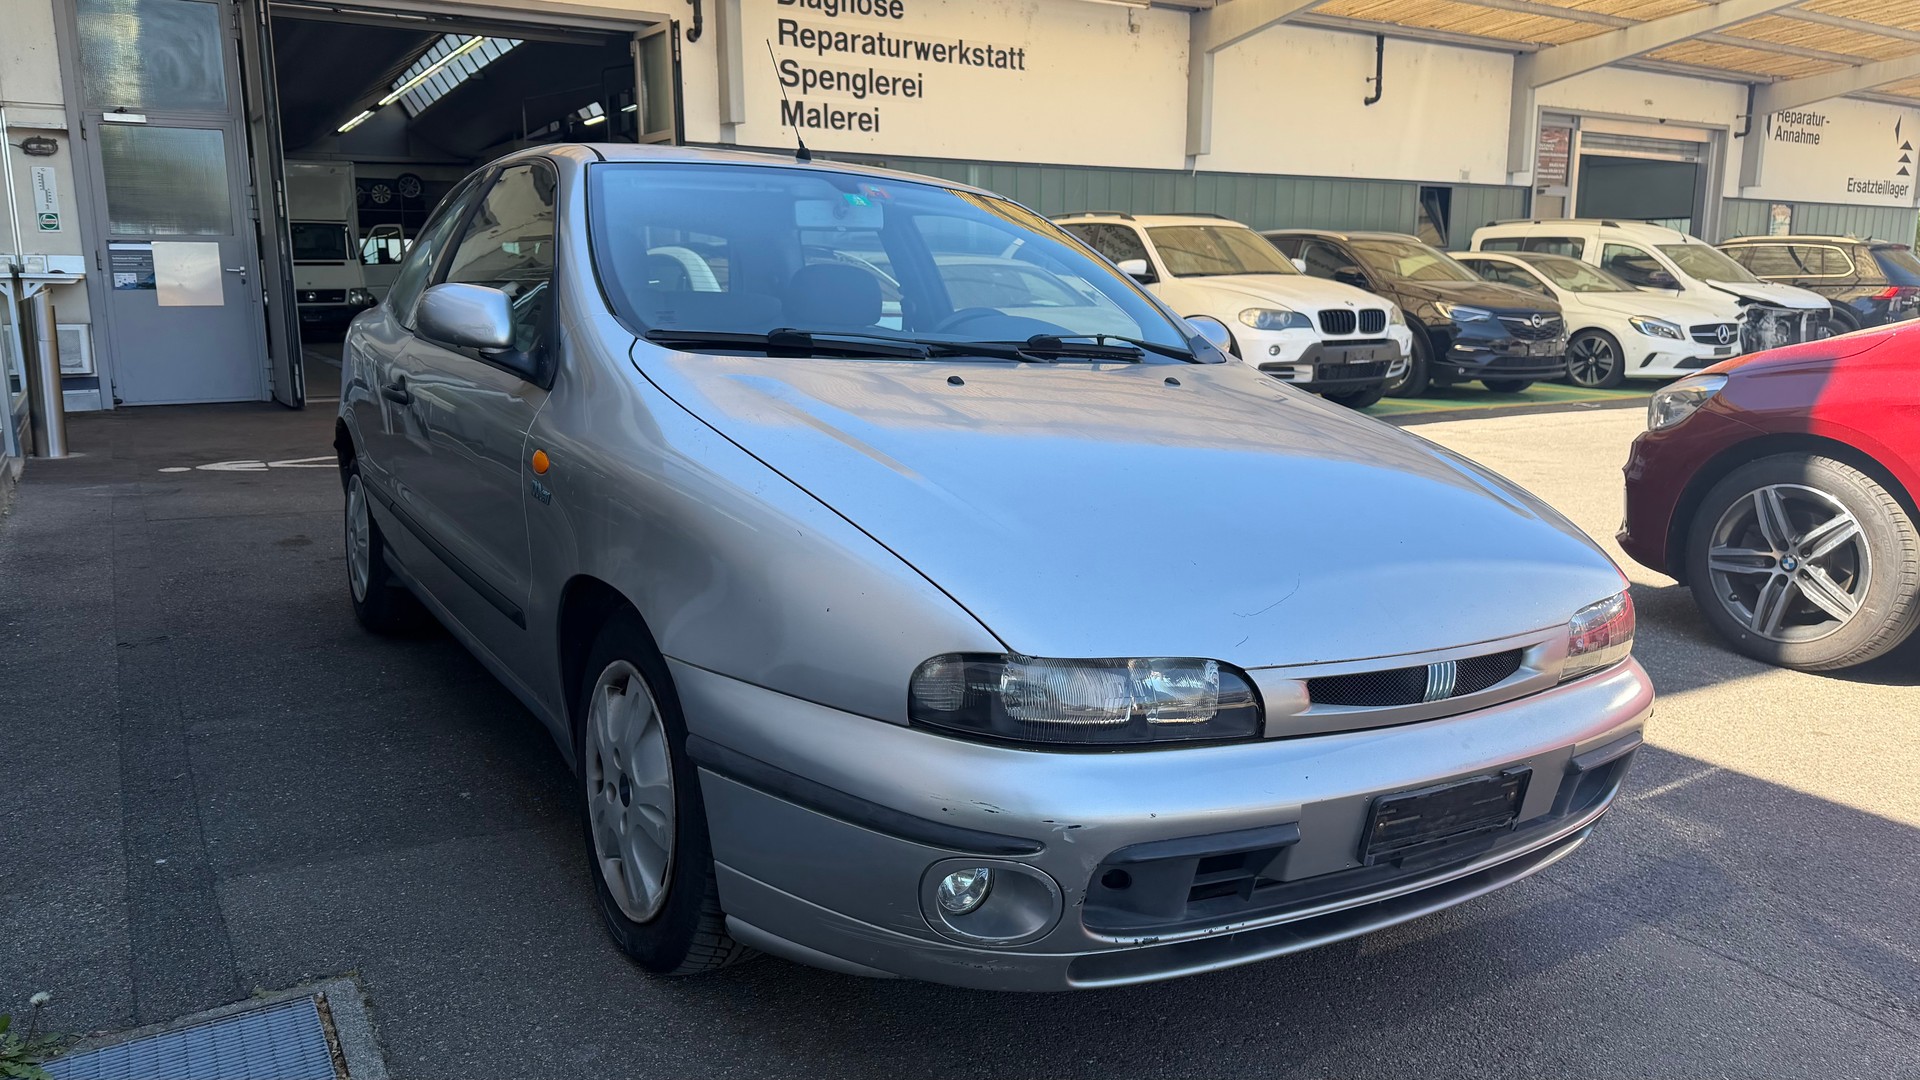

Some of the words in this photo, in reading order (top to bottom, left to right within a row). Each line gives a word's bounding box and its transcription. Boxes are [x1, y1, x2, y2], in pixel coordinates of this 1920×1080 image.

[777, 0, 904, 19] gnose
[778, 18, 1025, 71] Reparaturwerkstatt
[780, 59, 923, 99] Spenglerei
[780, 99, 880, 132] Malerei
[1777, 110, 1830, 127] Reparatur-
[1774, 125, 1820, 144] Annahme
[1847, 178, 1909, 198] Ersatzteillager
